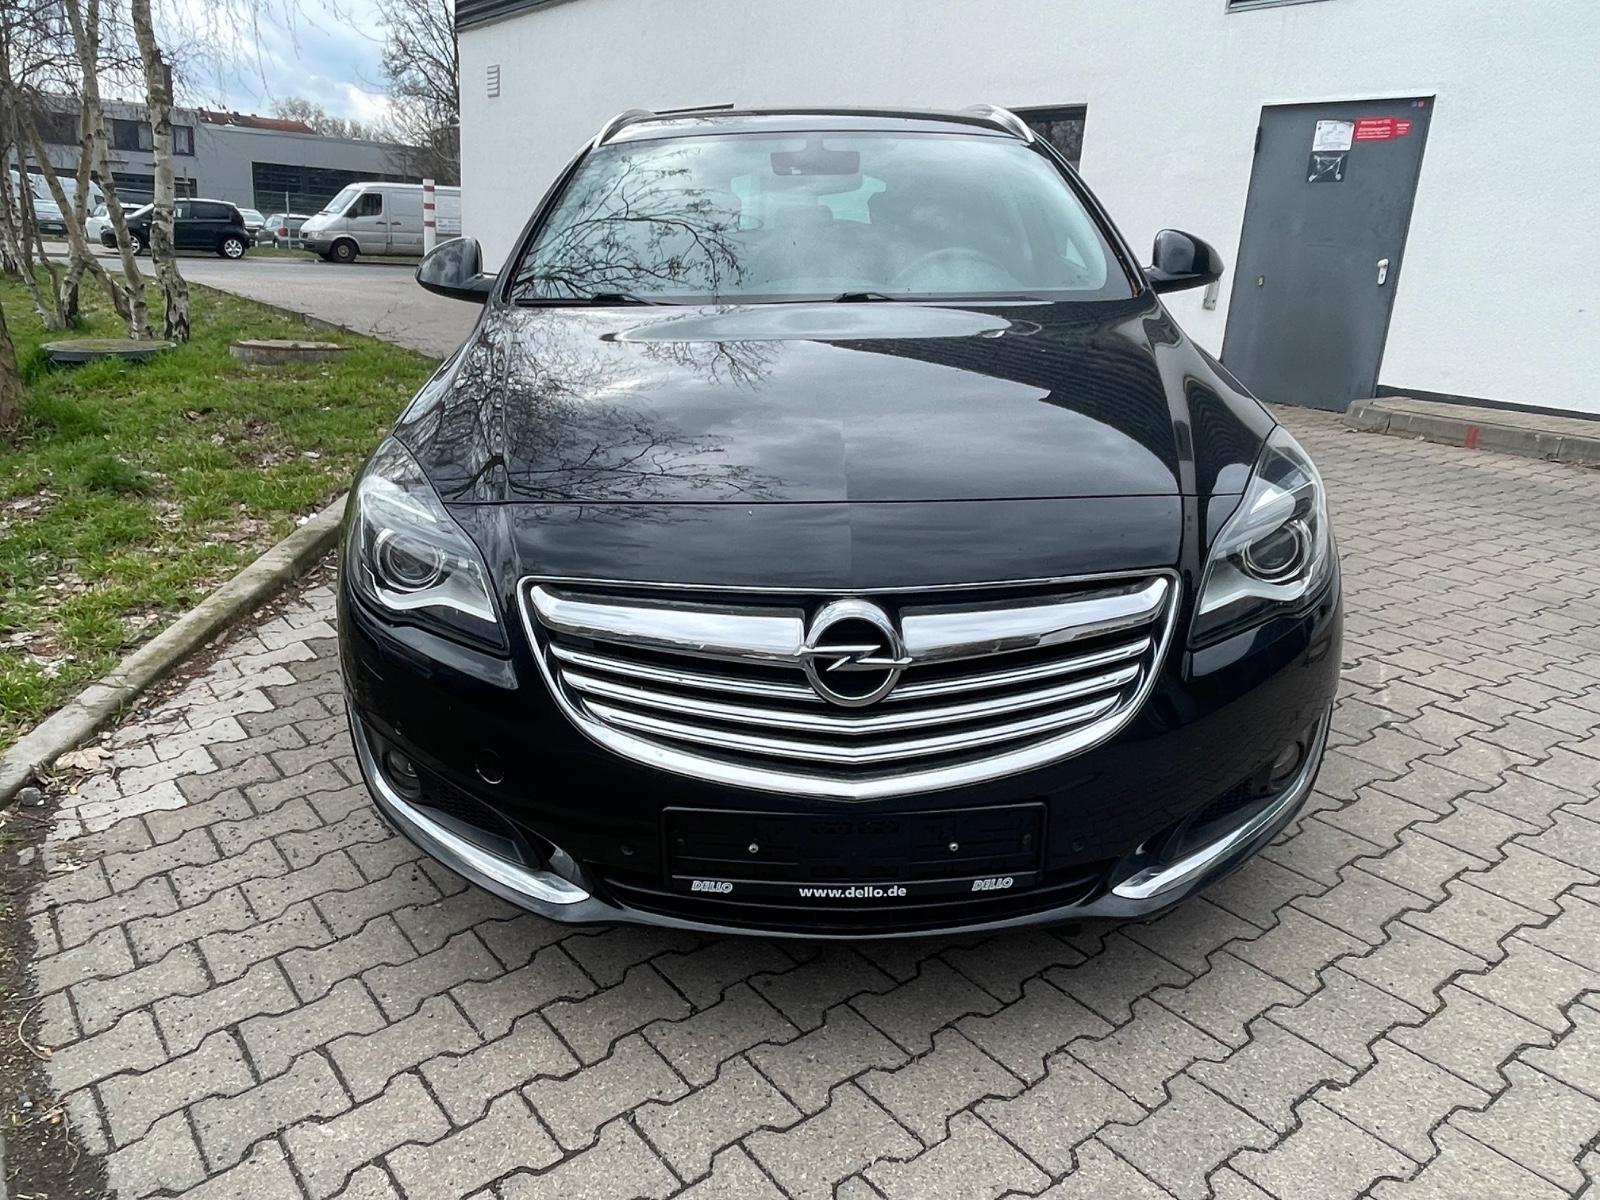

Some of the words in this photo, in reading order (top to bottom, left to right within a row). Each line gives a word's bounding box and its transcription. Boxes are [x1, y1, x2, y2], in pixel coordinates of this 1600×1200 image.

[691, 880, 733, 894] DELLO
[799, 885, 907, 898] www.dello.de
[971, 877, 1014, 892] DELLO
